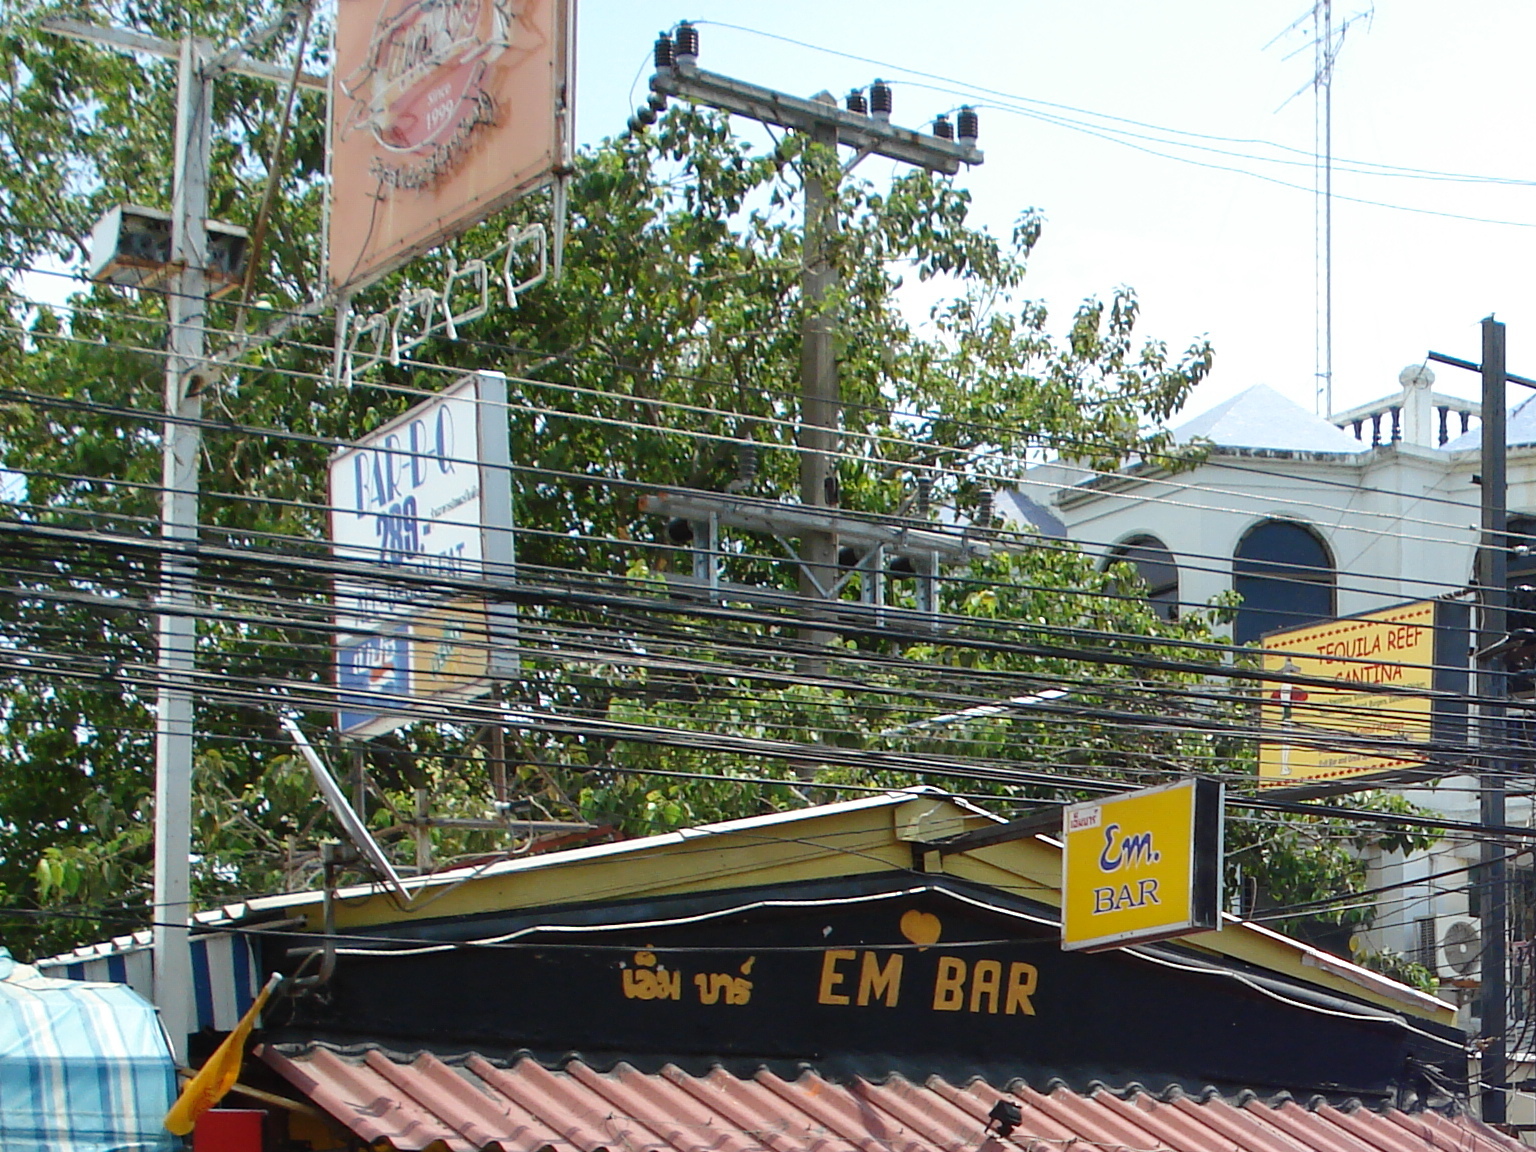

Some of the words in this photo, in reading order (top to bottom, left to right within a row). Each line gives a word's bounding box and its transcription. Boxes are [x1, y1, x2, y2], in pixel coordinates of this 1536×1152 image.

[353, 404, 455, 520] BAR-B-Q
[1316, 634, 1381, 665] TEQUILA
[1387, 625, 1423, 652] REEF
[1100, 823, 1160, 872] Em.
[1093, 879, 1160, 915] BAR
[818, 950, 904, 1009] EM
[932, 957, 1039, 1017] BAR
